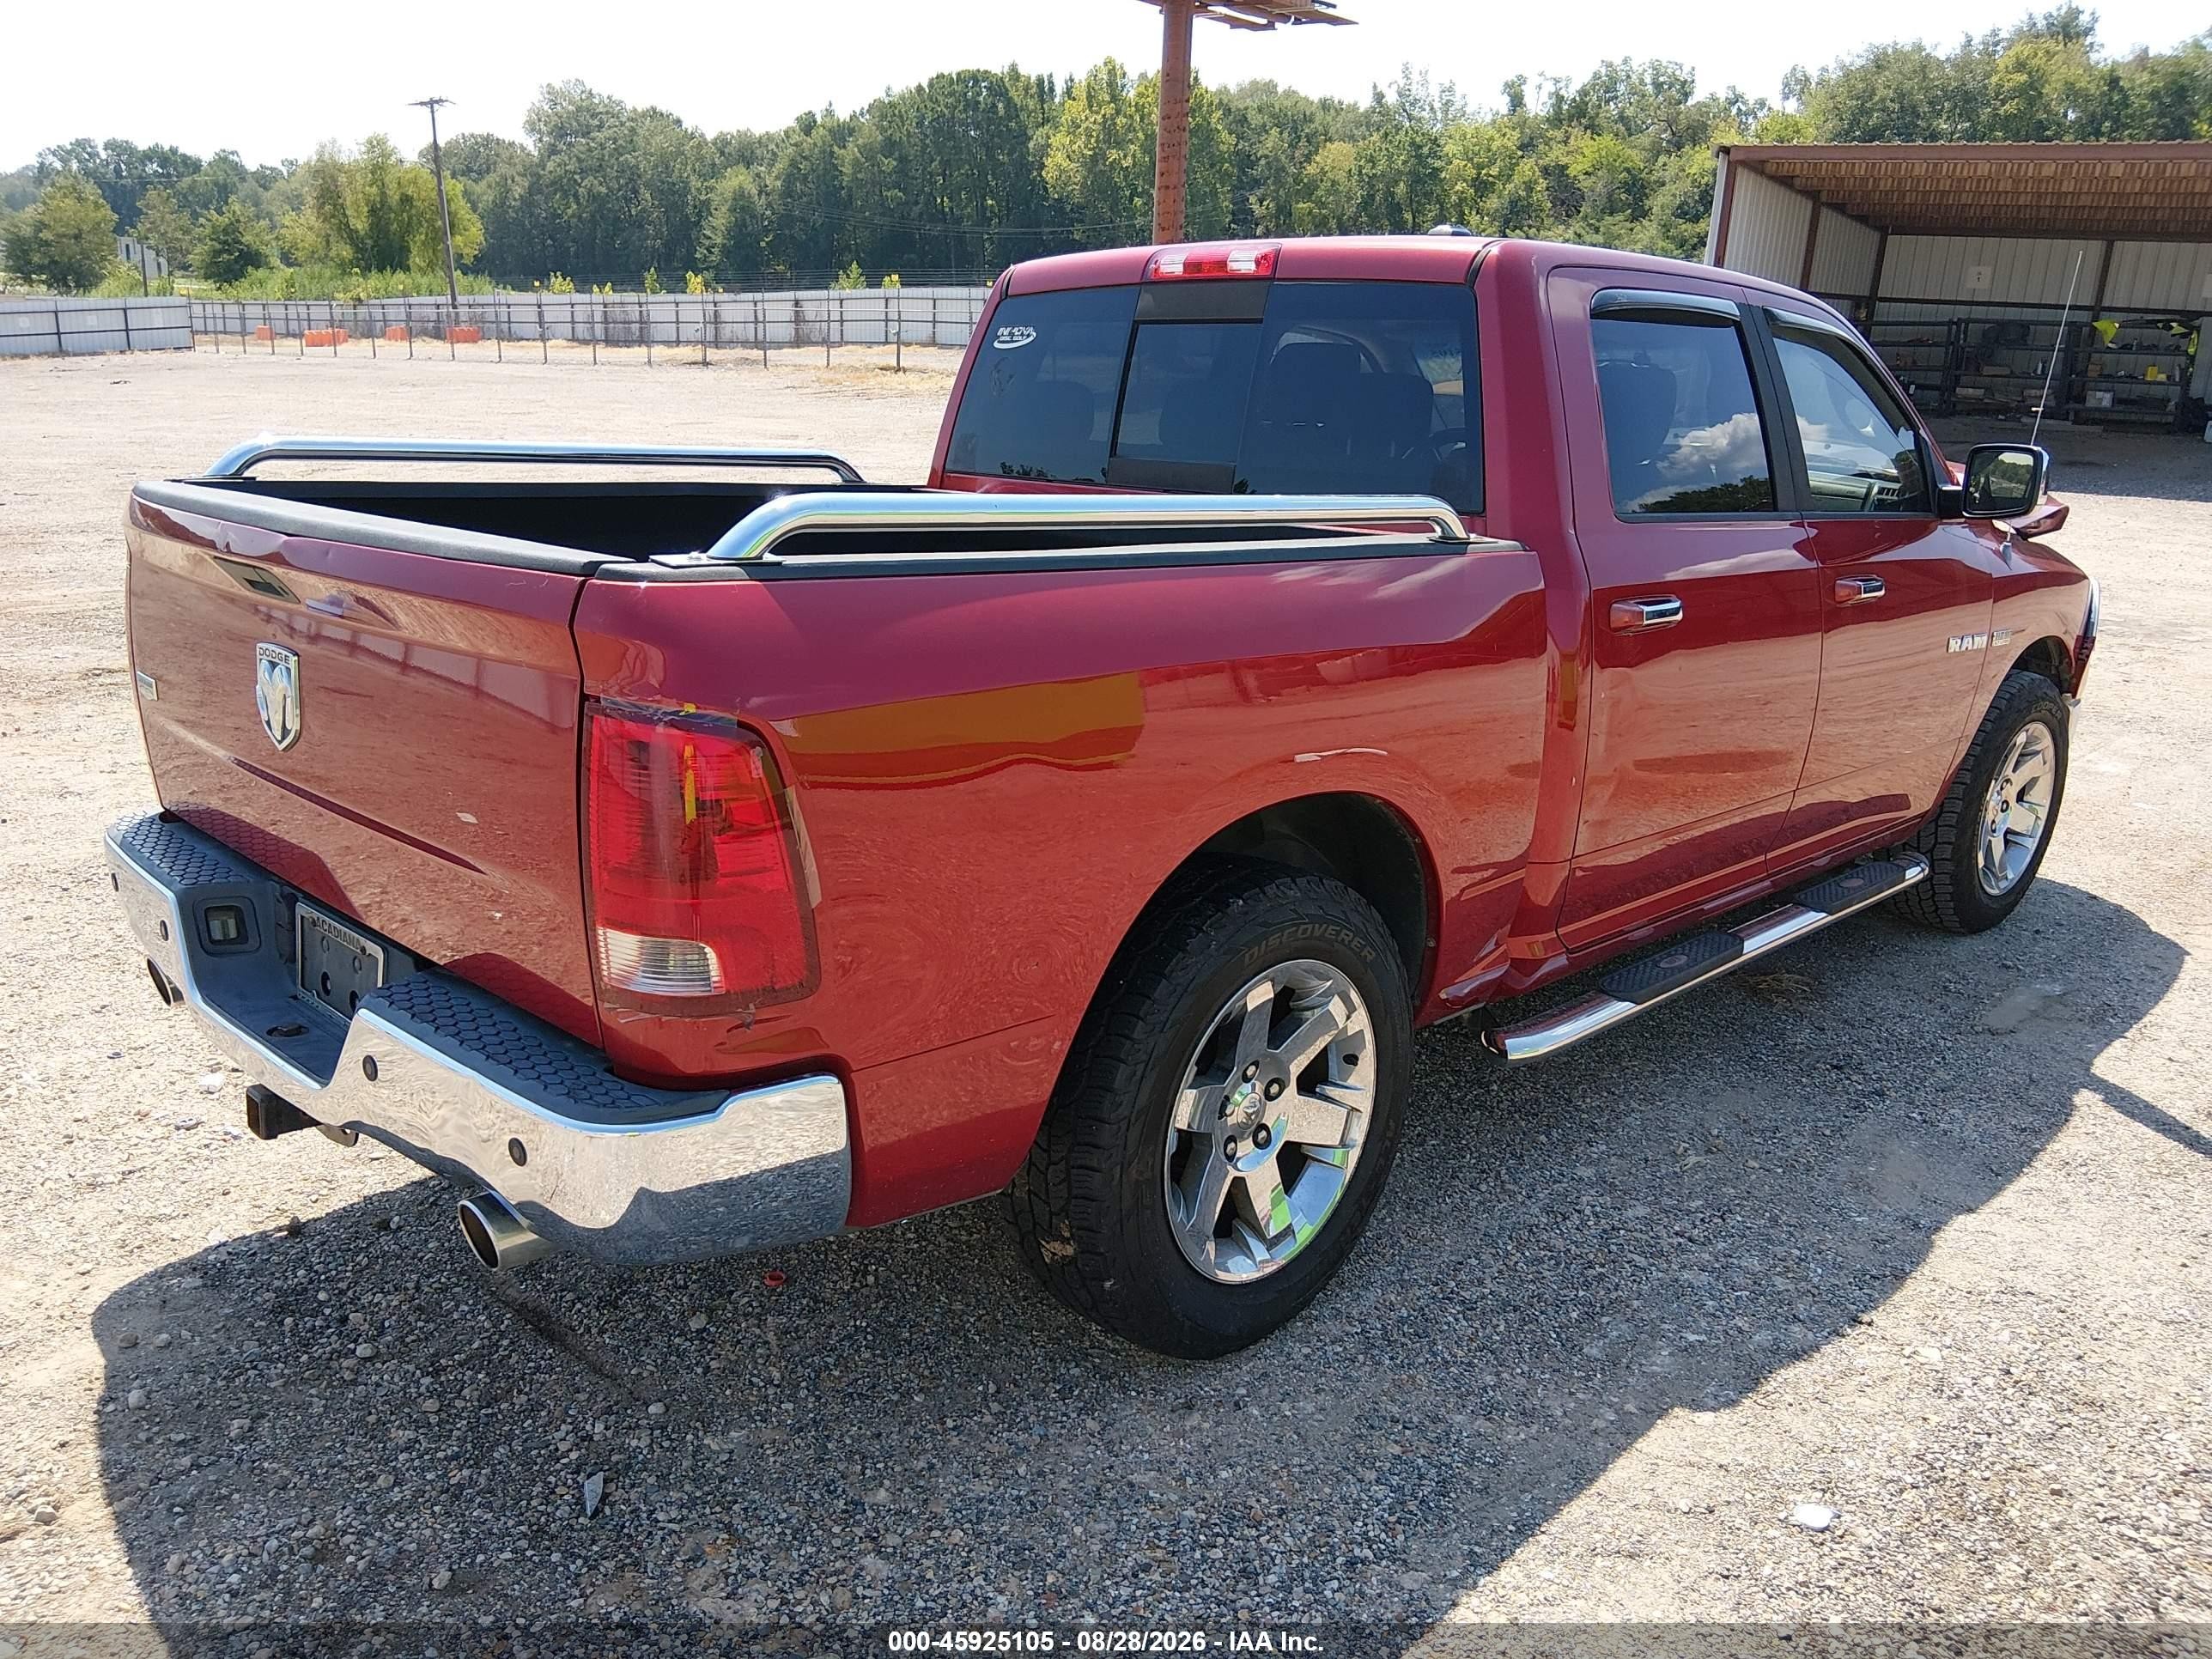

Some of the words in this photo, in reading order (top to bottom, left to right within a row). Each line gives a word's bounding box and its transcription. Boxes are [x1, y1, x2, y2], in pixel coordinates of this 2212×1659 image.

[258, 647, 290, 665] DODGE
[1947, 633, 1988, 653] RAM
[315, 916, 361, 950] ACADIANA
[1244, 923, 1376, 963] DISCOVERER
